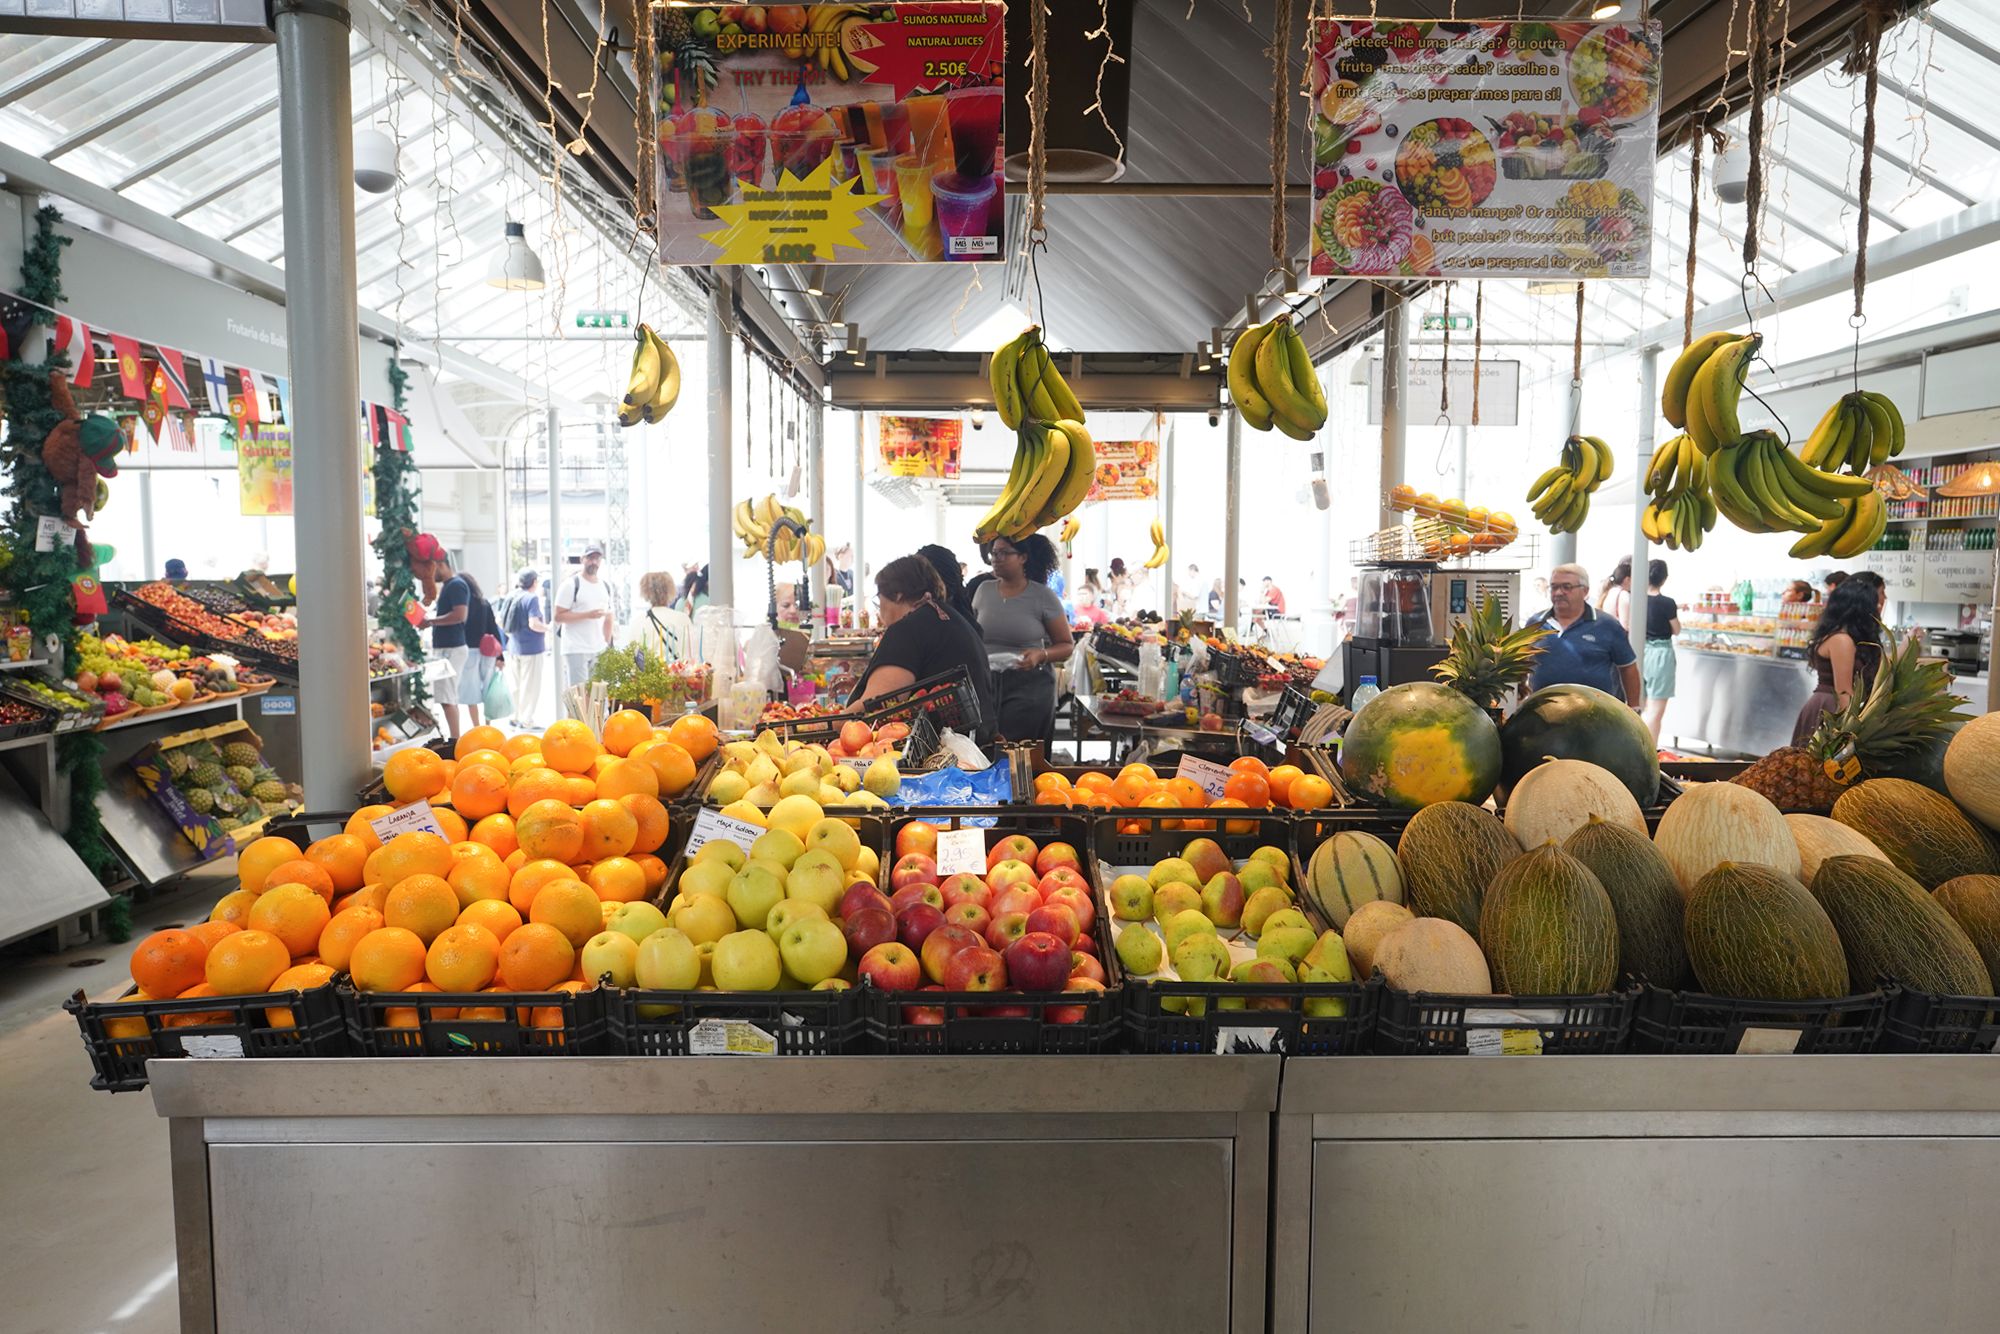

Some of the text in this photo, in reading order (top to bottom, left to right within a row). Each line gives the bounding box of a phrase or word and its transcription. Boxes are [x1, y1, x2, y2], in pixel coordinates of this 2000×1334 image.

[903, 14, 988, 25] SUMOS NATURAIS
[716, 32, 841, 49] EXPERIMENTE!
[907, 36, 984, 47] NATURAL JUICES
[1335, 35, 1414, 49] Apetece-lhe
[1418, 38, 1447, 48] uma
[1506, 37, 1526, 49] Ou
[1529, 38, 1566, 49] outra
[925, 62, 967, 76] 2.50€
[1381, 63, 1410, 73] mas
[1497, 61, 1548, 75] Escolha
[1550, 65, 1559, 75] a
[735, 68, 826, 85] TRY THEM!
[1511, 89, 1542, 103] para
[1544, 87, 1562, 100] si!
[1418, 205, 1457, 220] Fancy
[1459, 208, 1468, 217] a
[1470, 205, 1524, 221] mango?
[1525, 205, 1544, 218] Or
[1545, 207, 1600, 219] another
[1431, 228, 1456, 242] but
[1457, 229, 1511, 245] peeled?
[1512, 230, 1562, 243] Choose
[1562, 230, 1588, 243] the
[1443, 255, 1486, 269] we've
[1486, 256, 1549, 271] prepared
[1551, 255, 1572, 269] for
[1571, 256, 1604, 271] you!
[227, 317, 258, 341] Frutaria
[259, 328, 270, 344] do
[388, 810, 416, 824] LARANJA
